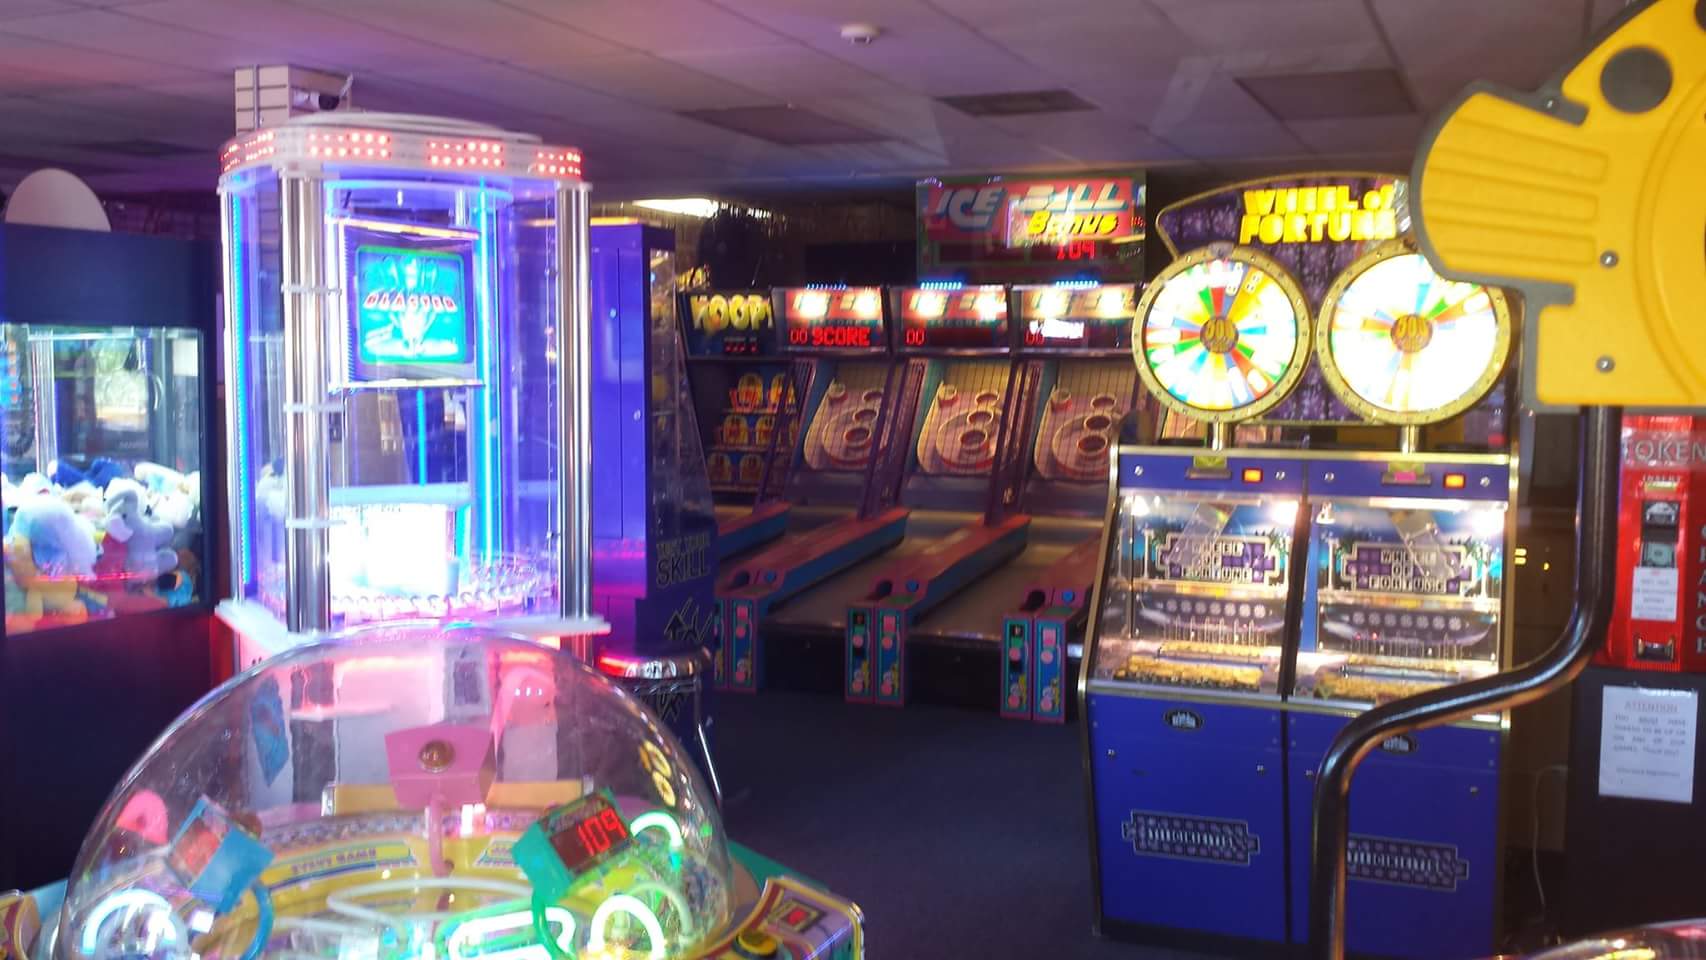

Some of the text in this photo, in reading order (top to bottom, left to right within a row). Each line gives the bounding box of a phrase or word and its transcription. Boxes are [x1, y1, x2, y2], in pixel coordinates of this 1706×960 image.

[930, 181, 1127, 231] ICE BALL
[1243, 184, 1359, 216] WHEEL
[1027, 211, 1119, 236] Bonus
[1239, 208, 1397, 245] FORTUNE
[1056, 239, 1096, 261] 109
[811, 326, 871, 347] SCORE
[656, 548, 711, 589] SKILL
[576, 805, 628, 858] 109
